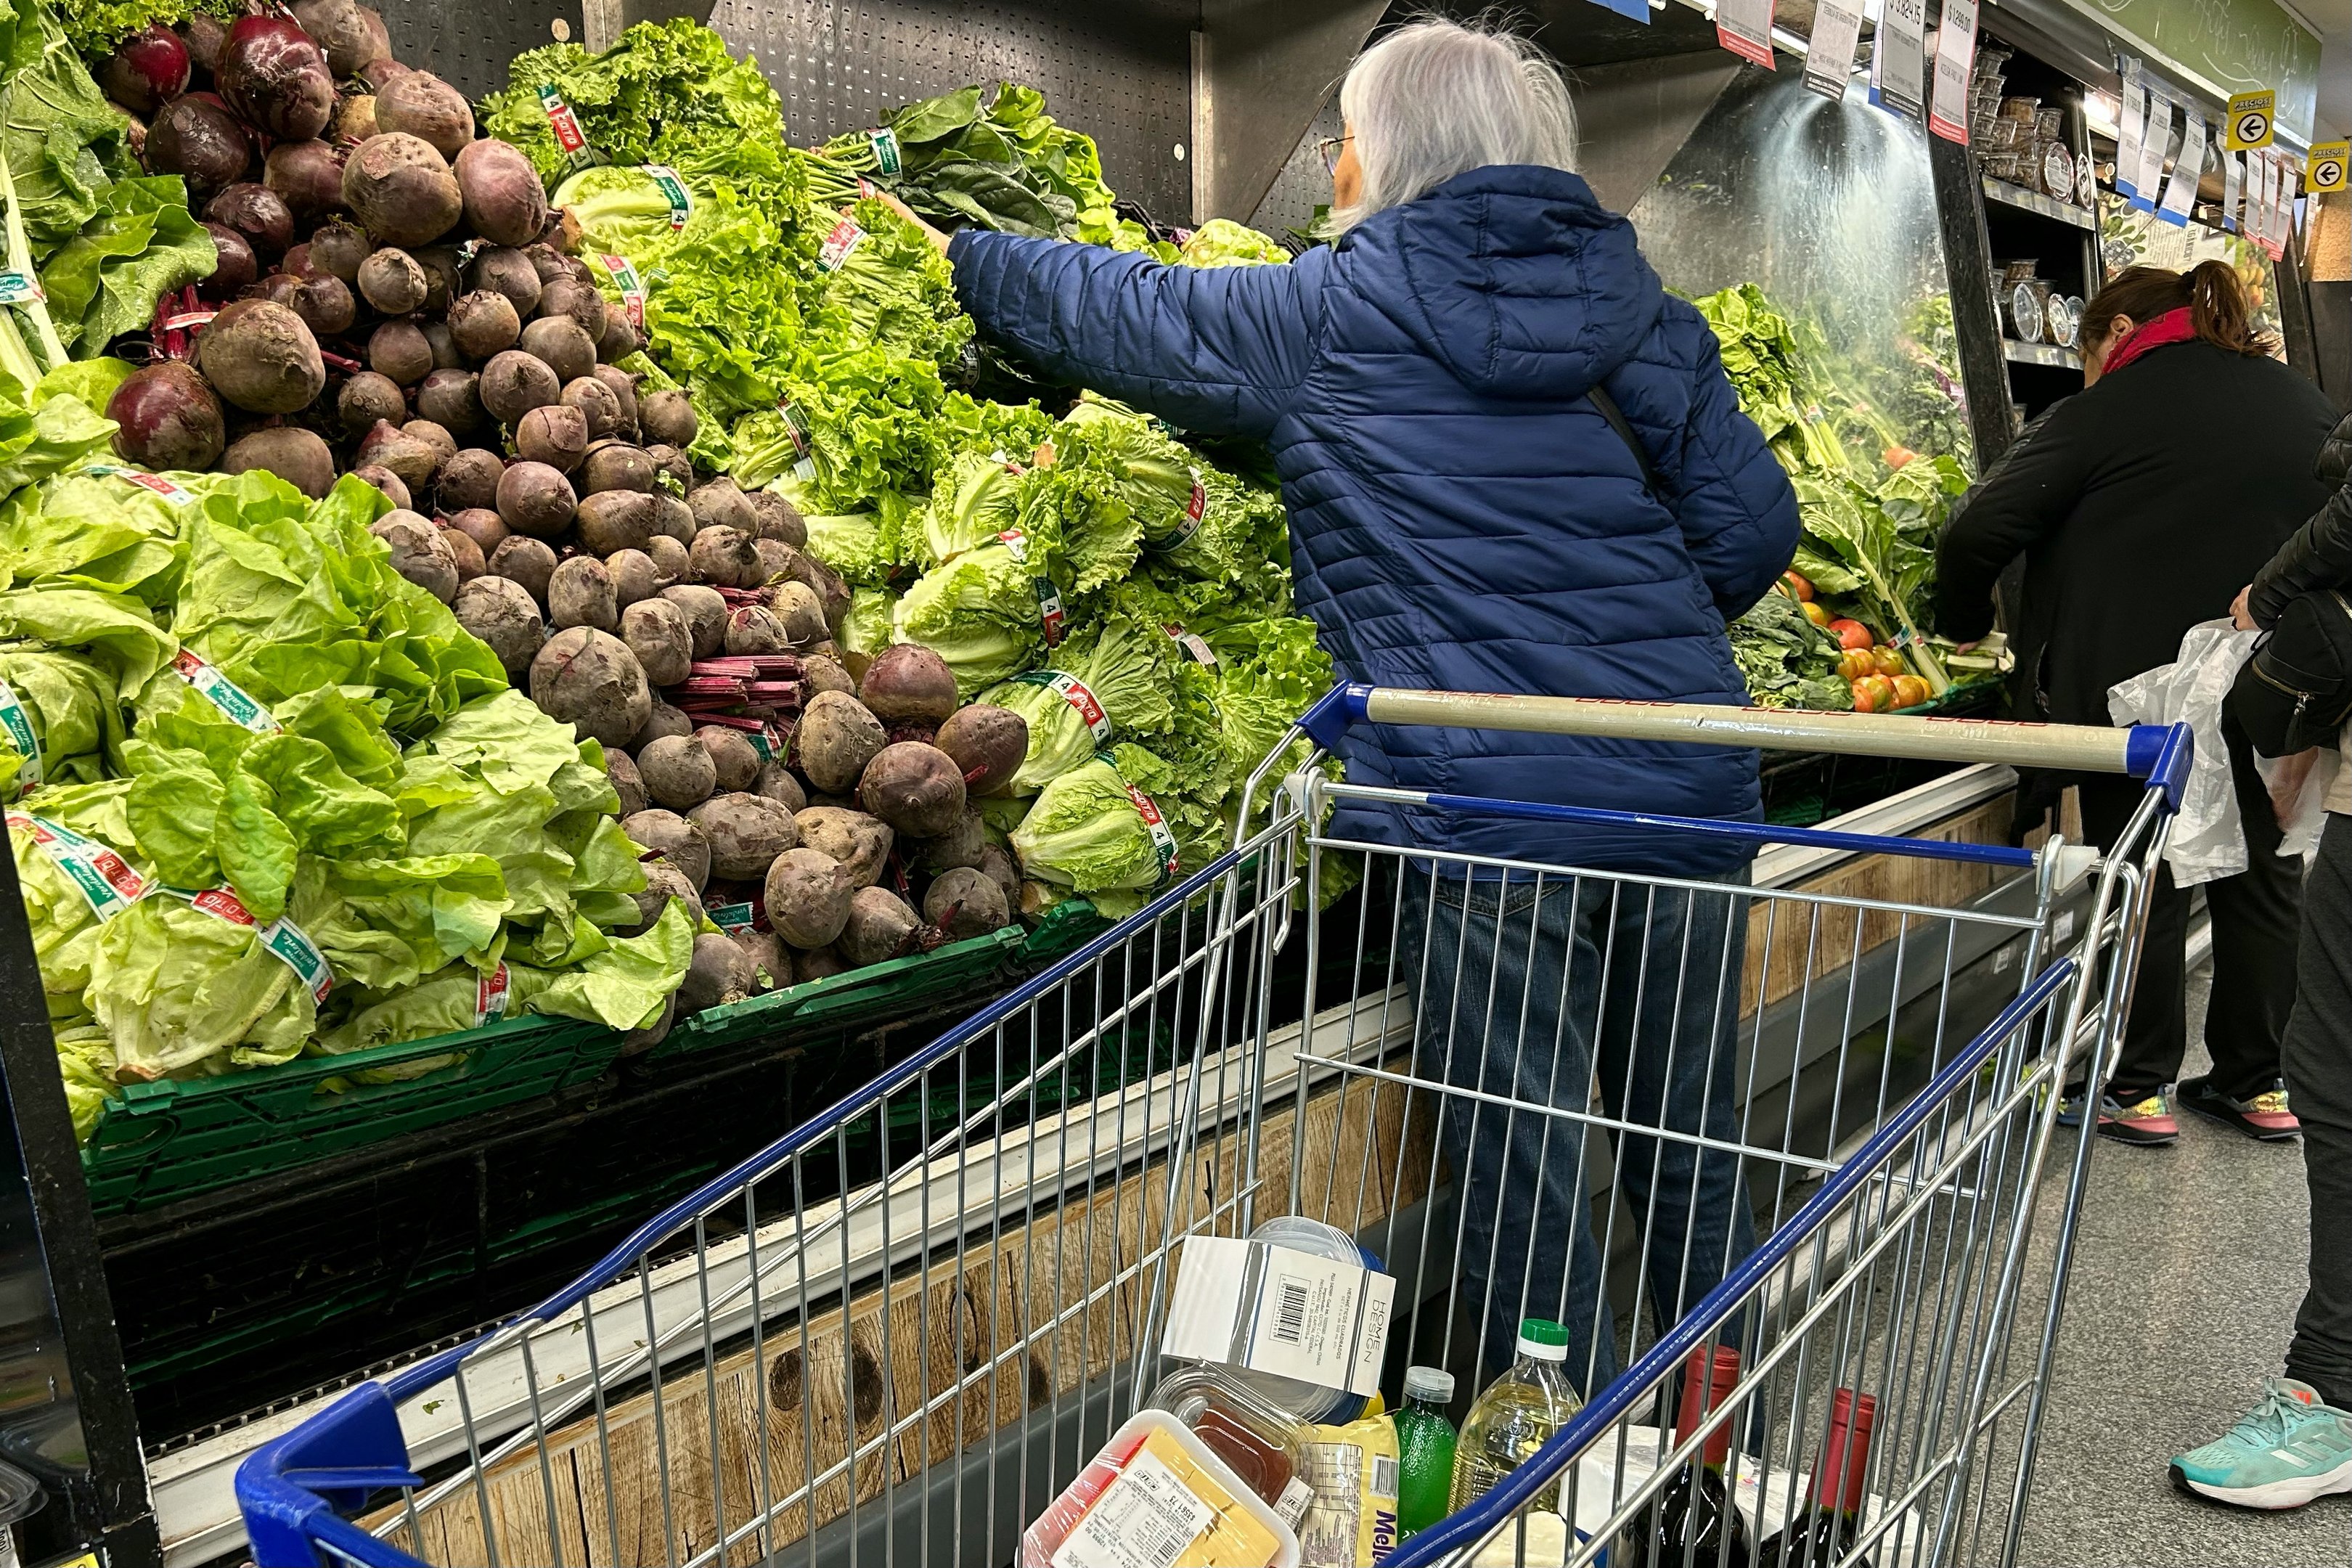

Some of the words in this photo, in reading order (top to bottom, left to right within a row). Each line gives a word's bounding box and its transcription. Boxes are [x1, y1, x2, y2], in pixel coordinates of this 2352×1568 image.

[1045, 603, 1056, 613] 4
[1342, 1288, 1352, 1323] HERMÉTICOS
[1336, 1325, 1345, 1360] CUADRADOS
[1364, 1299, 1380, 1363] DESIGN
[1373, 1302, 1386, 1350] HOME
[1134, 1469, 1160, 1493] COTO
[1161, 1498, 1173, 1509] Total
